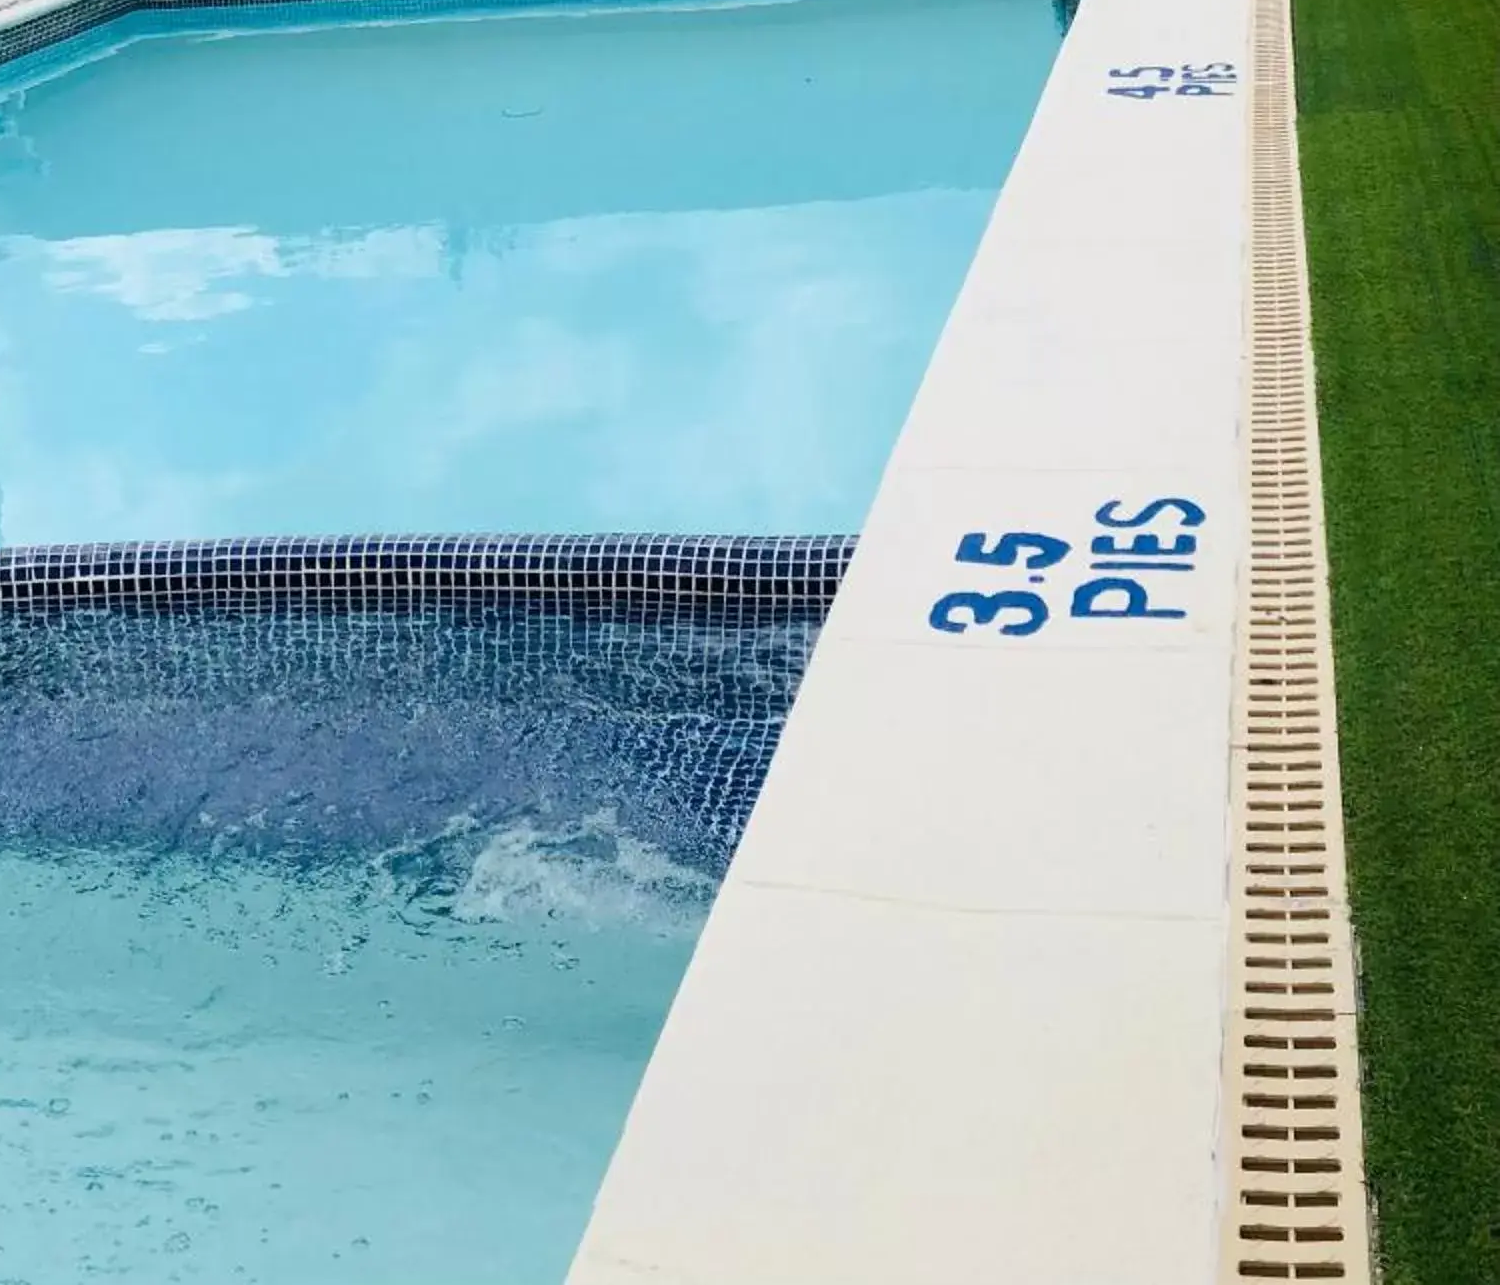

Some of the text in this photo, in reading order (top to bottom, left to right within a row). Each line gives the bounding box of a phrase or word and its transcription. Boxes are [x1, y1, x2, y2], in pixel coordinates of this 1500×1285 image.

[1175, 63, 1237, 96] PIES
[928, 531, 1073, 636] 3.5
[1070, 497, 1207, 619] PIES
